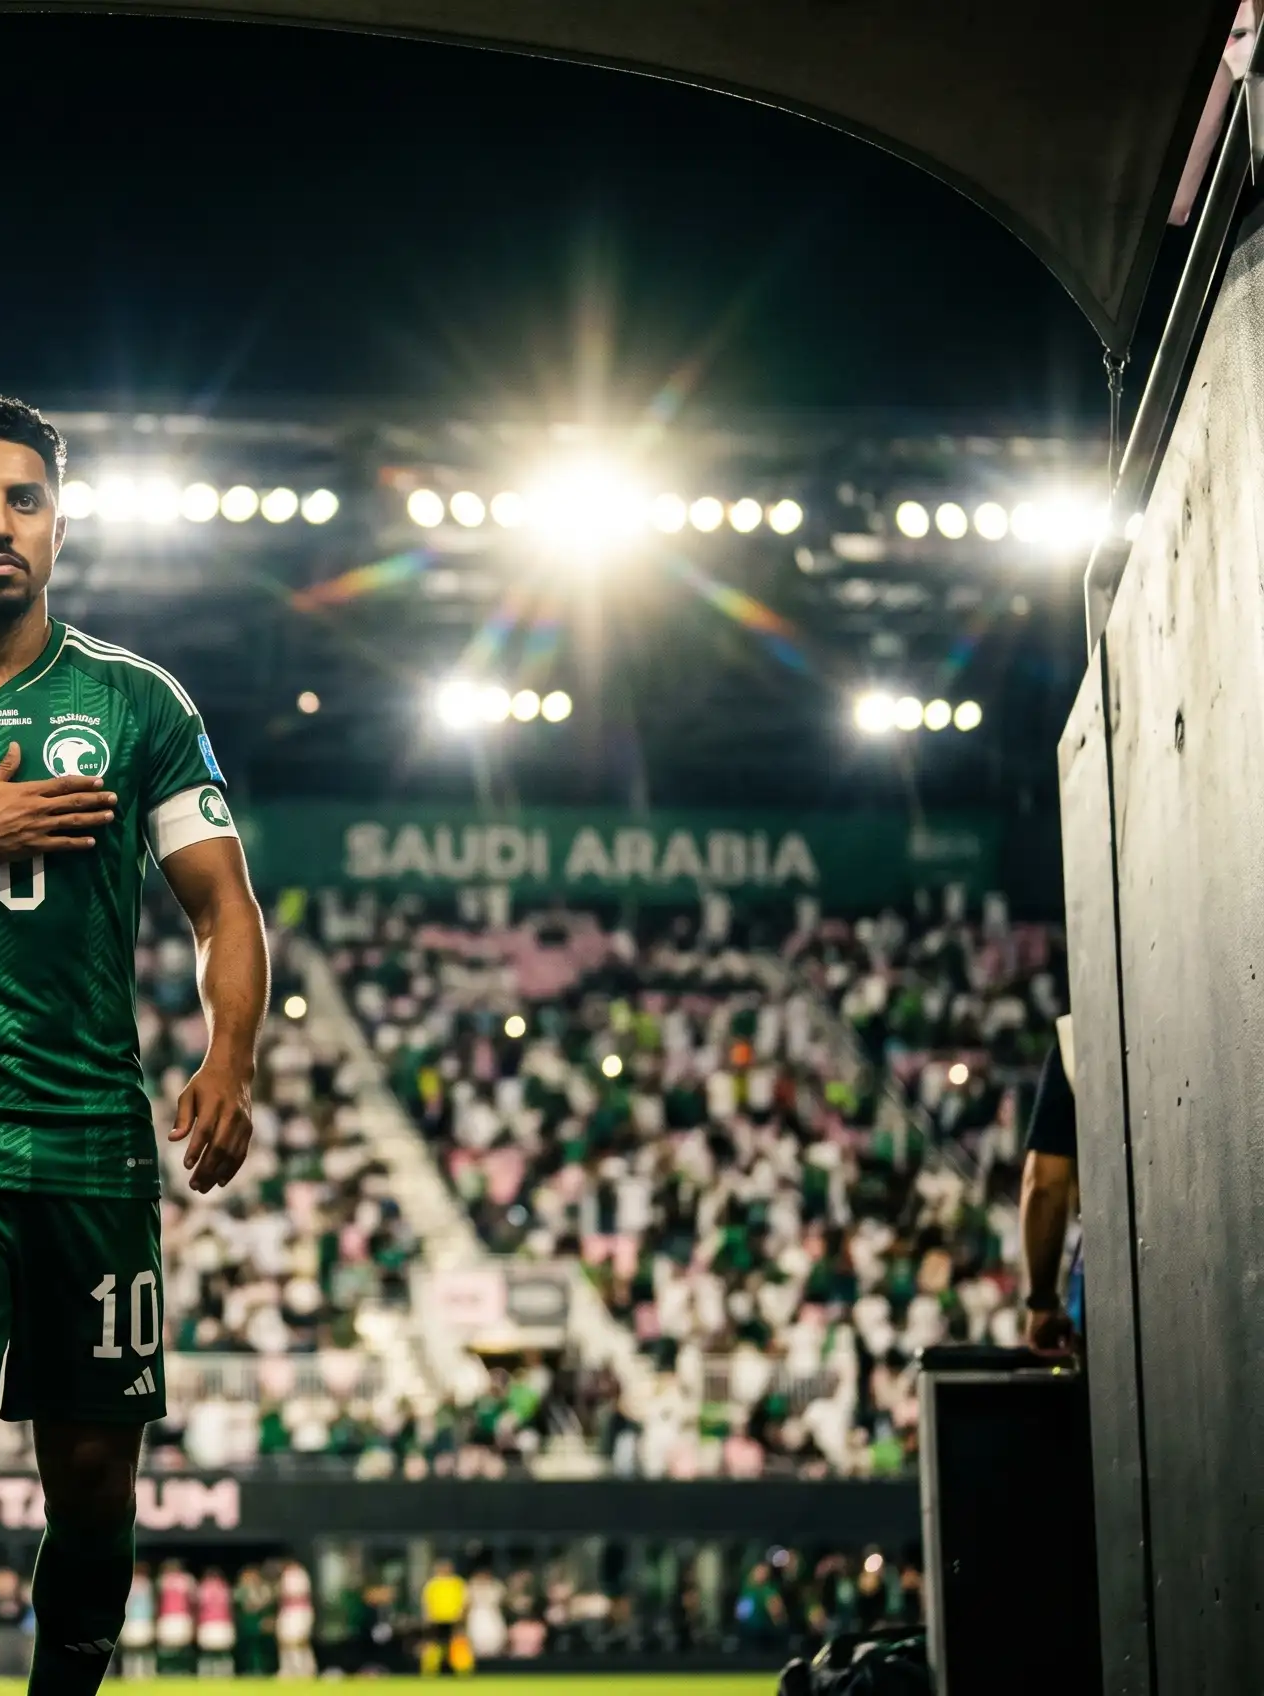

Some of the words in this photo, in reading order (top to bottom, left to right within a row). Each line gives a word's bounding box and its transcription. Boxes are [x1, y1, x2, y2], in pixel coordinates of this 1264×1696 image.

[346, 822, 549, 880] SAUDI
[565, 825, 821, 887] ARABIA
[90, 1270, 160, 1359] 10
